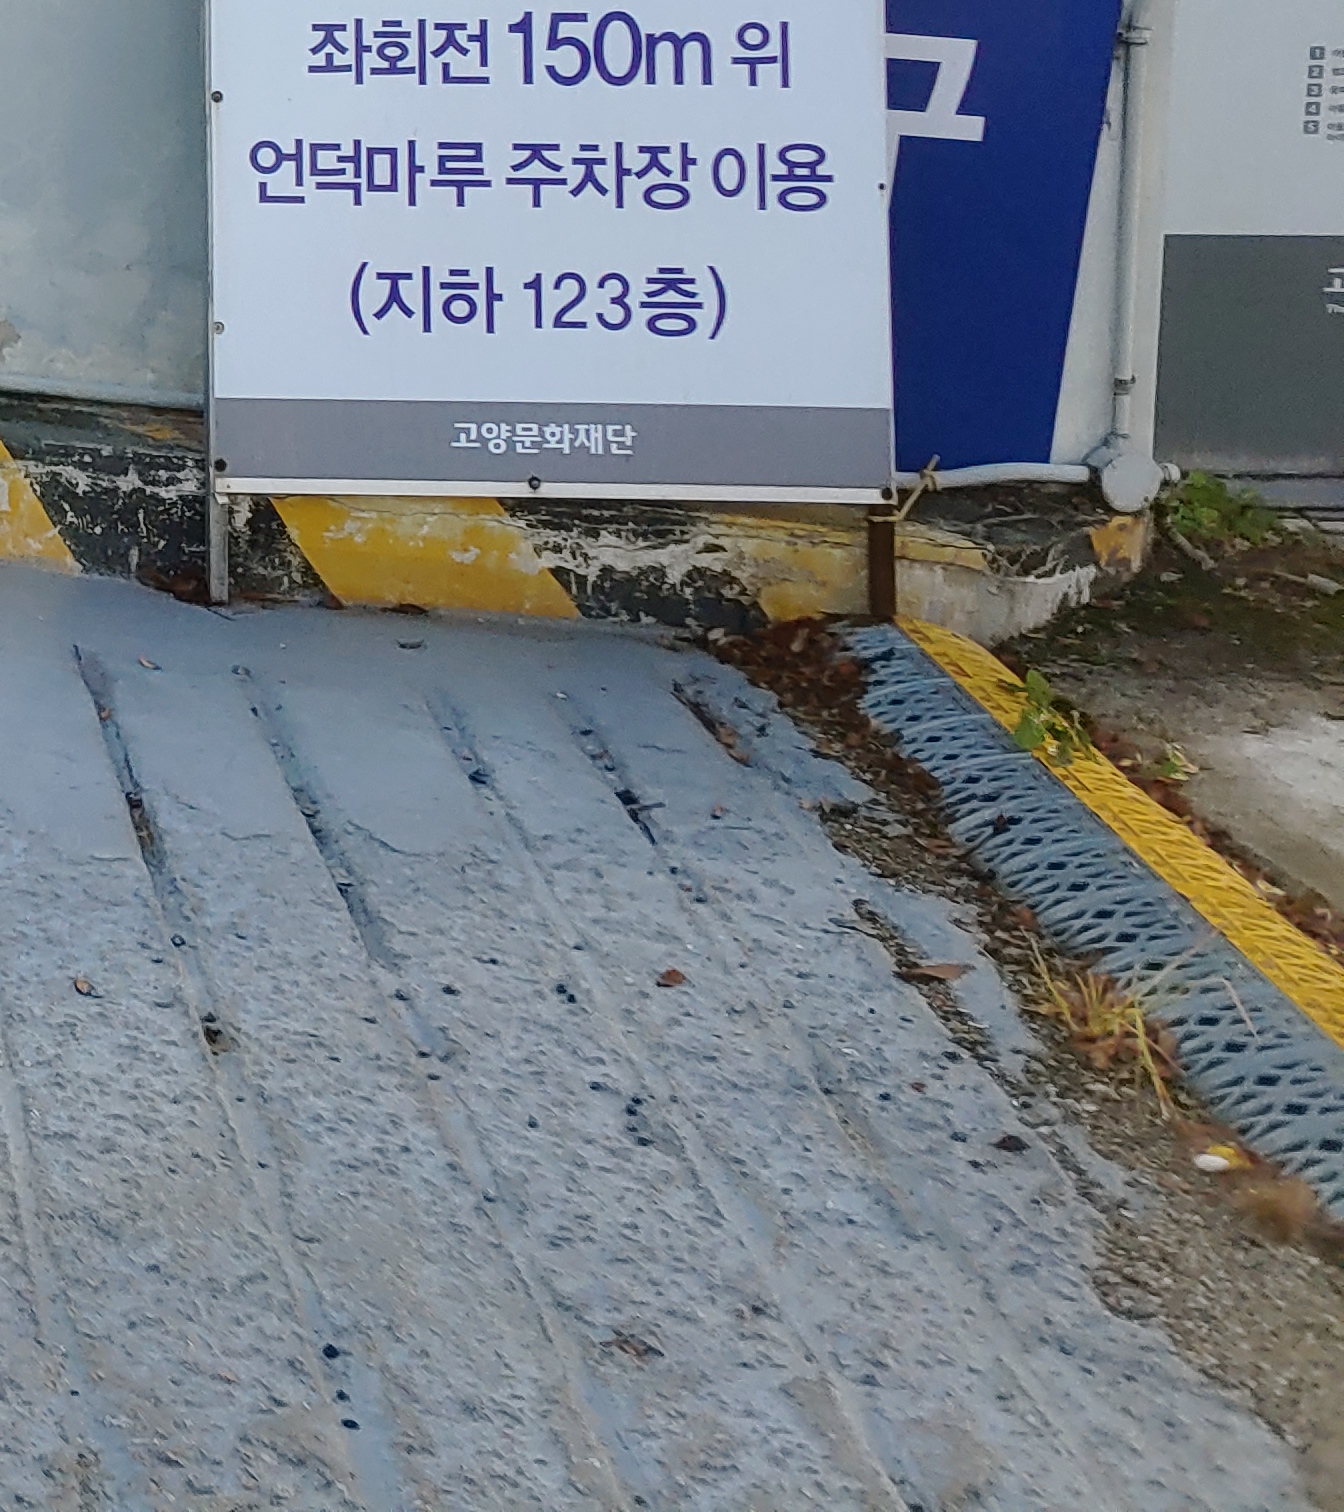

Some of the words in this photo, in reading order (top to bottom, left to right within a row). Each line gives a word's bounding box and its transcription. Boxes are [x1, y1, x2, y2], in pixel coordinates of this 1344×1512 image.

[307, 17, 491, 86] 좌회전
[507, 10, 713, 87] 150m
[730, 21, 791, 89] 위
[249, 138, 493, 208] 언덕마루
[505, 141, 698, 211] 주차장
[712, 141, 835, 213] 이용
[350, 261, 505, 336] (지하
[523, 265, 728, 340] 123층)
[449, 421, 638, 456] 고양문화재단
